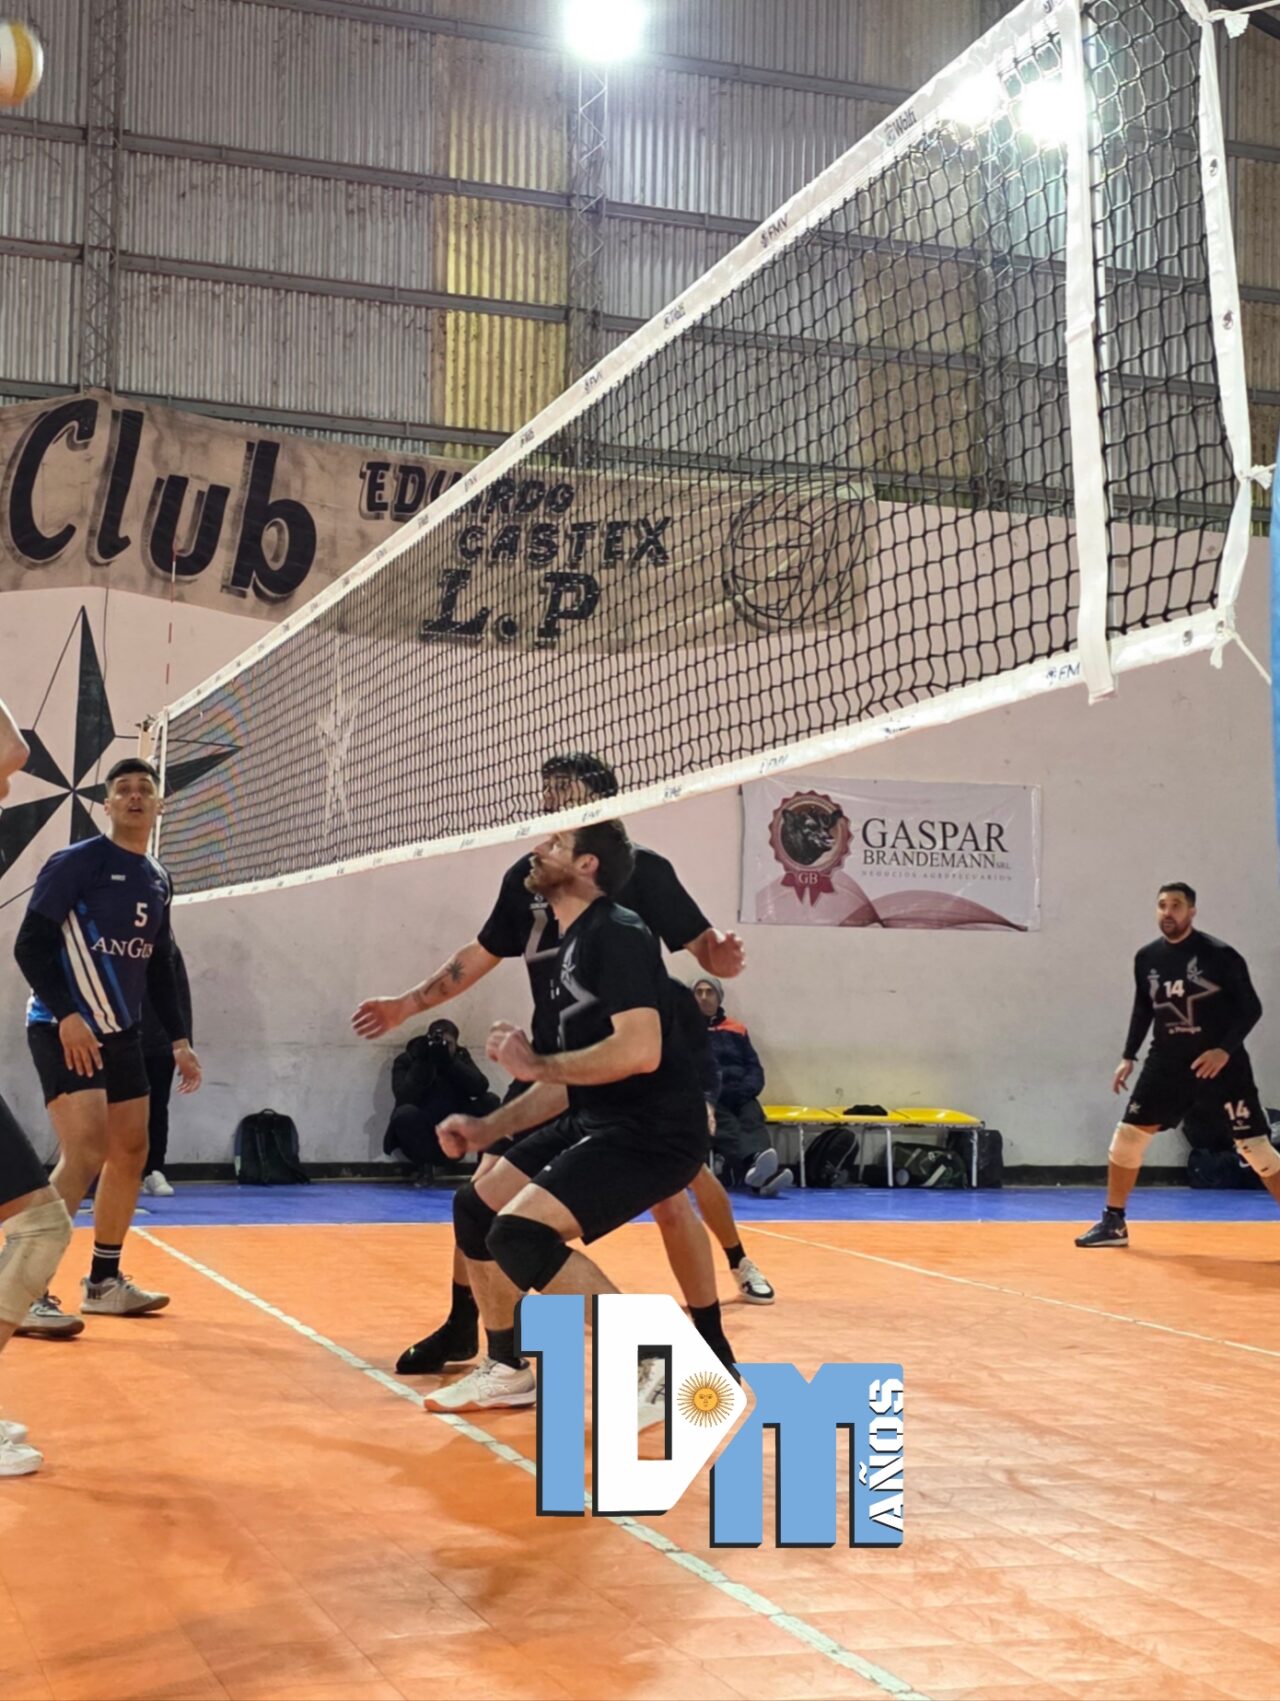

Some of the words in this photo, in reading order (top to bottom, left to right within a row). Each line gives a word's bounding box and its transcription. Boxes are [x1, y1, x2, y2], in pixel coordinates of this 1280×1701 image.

[6, 397, 317, 599] Club
[455, 516, 672, 568] CASTEX
[1058, 661, 1081, 680] FM
[862, 818, 1009, 853] GASPAR
[862, 849, 996, 869] BRANDEMANN
[798, 872, 819, 885] GB
[134, 902, 149, 928] 5
[1163, 979, 1186, 998] 14
[1224, 1100, 1250, 1120] 14
